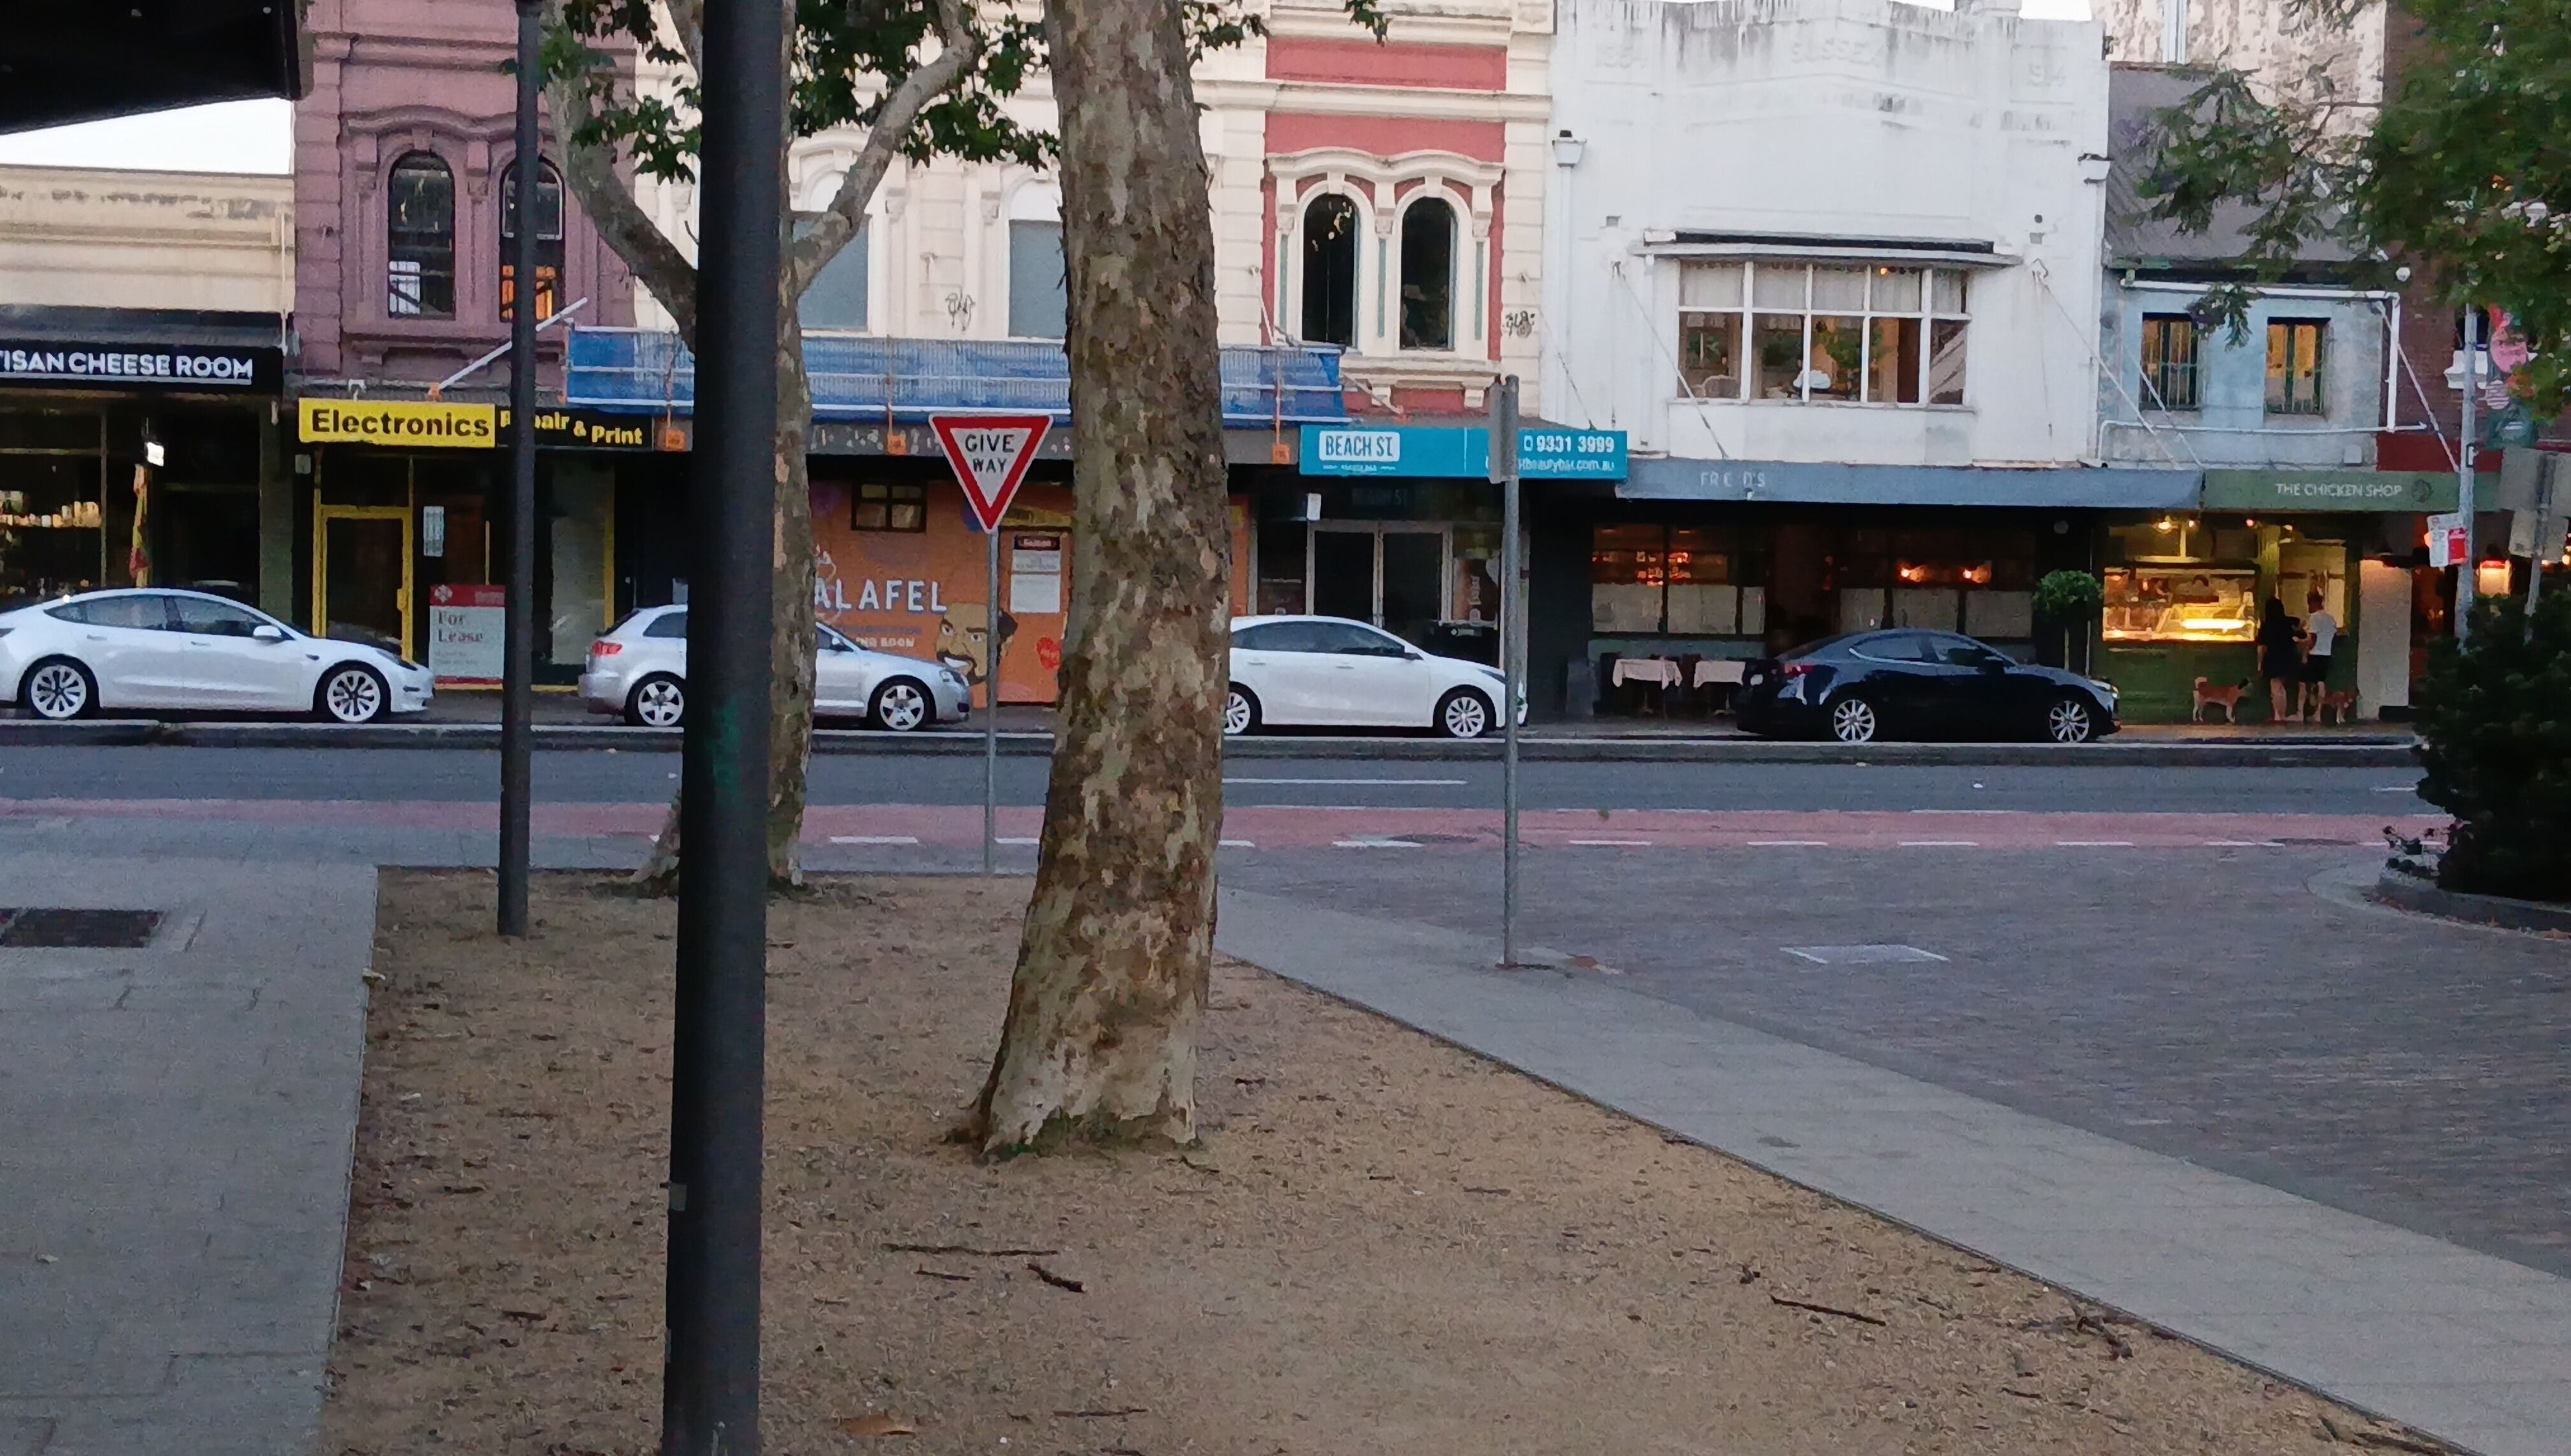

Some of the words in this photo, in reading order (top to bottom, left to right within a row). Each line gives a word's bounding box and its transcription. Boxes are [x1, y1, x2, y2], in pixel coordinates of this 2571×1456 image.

[68, 352, 170, 376] CHEESE
[176, 355, 252, 378] ROOM
[312, 409, 489, 436] Electronics
[573, 420, 587, 436] &
[592, 425, 643, 445] Print
[965, 433, 1014, 453] GIVE
[1326, 435, 1372, 457] BEACH
[1537, 435, 1571, 453] 9331
[1577, 435, 1614, 453] 3999
[973, 458, 1007, 474] WAY
[2275, 483, 2300, 496] THE
[2304, 483, 2362, 497] CHICKEN
[2365, 483, 2402, 497] SHOP
[814, 578, 947, 611] ALAFEL
[438, 610, 465, 625] For
